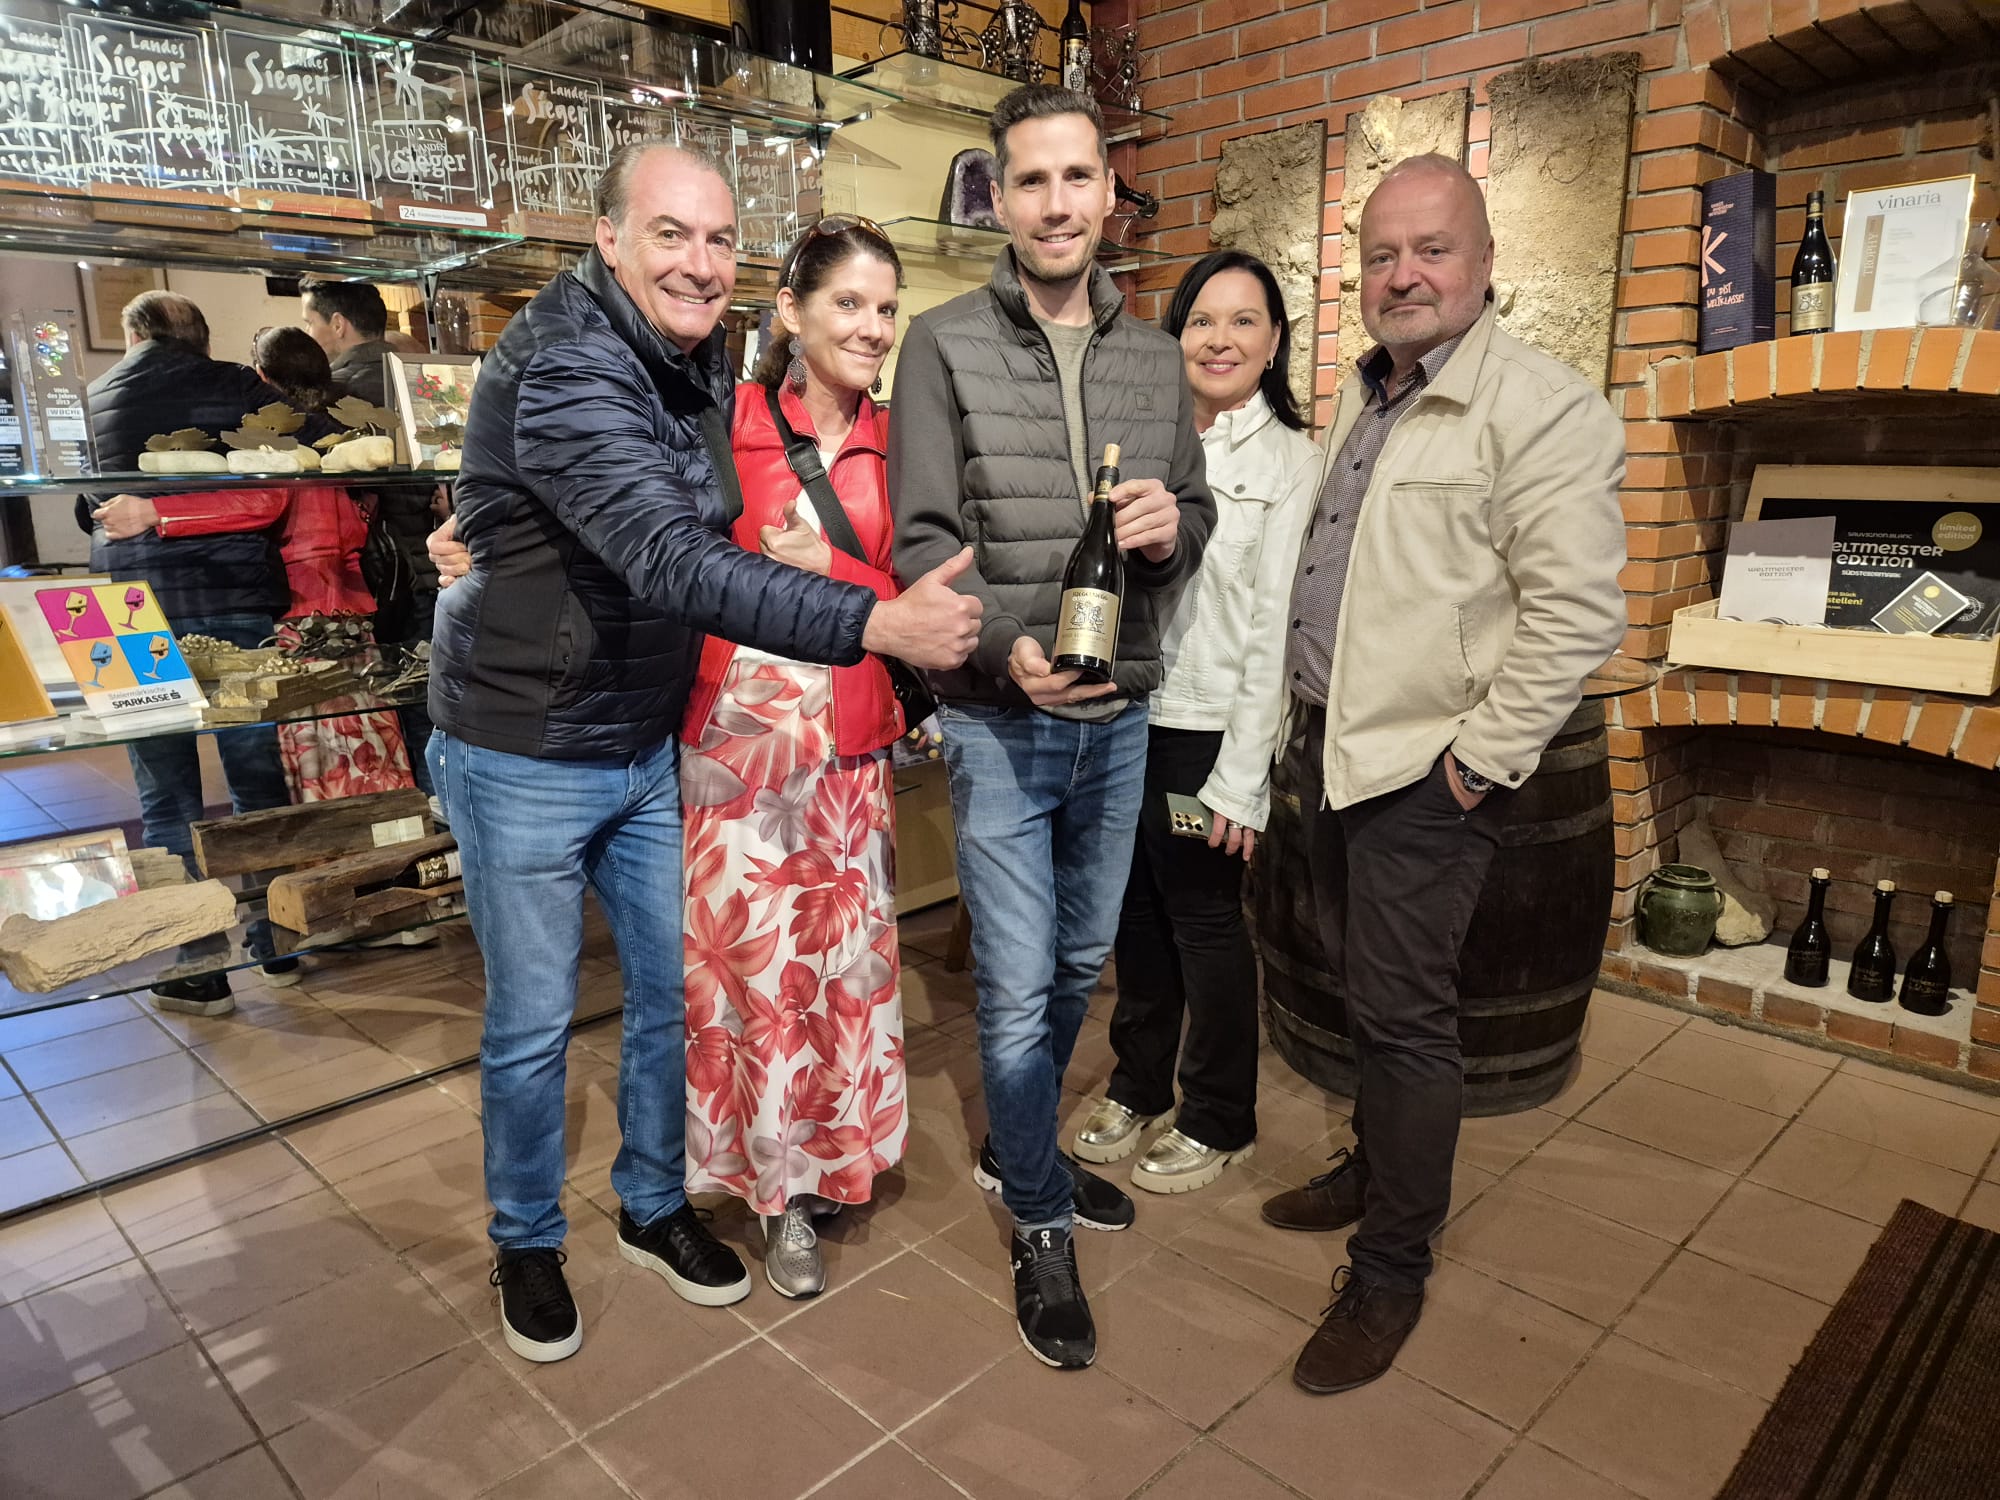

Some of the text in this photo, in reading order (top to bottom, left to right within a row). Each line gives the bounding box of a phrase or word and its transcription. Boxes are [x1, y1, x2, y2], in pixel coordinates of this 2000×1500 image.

[129, 31, 185, 59] Landes
[91, 34, 186, 89] Sieger
[244, 51, 330, 101] Sieger
[549, 79, 589, 102] Landes
[522, 82, 589, 130] Sieger
[1877, 190, 1941, 211] vinaria
[1701, 225, 1729, 288] K
[1863, 232, 1879, 278] TROPHY
[1937, 531, 1974, 541] edition
[1939, 523, 1976, 533] limited
[1827, 596, 1864, 606] stellen!
[112, 694, 170, 709] SPARKASSE
